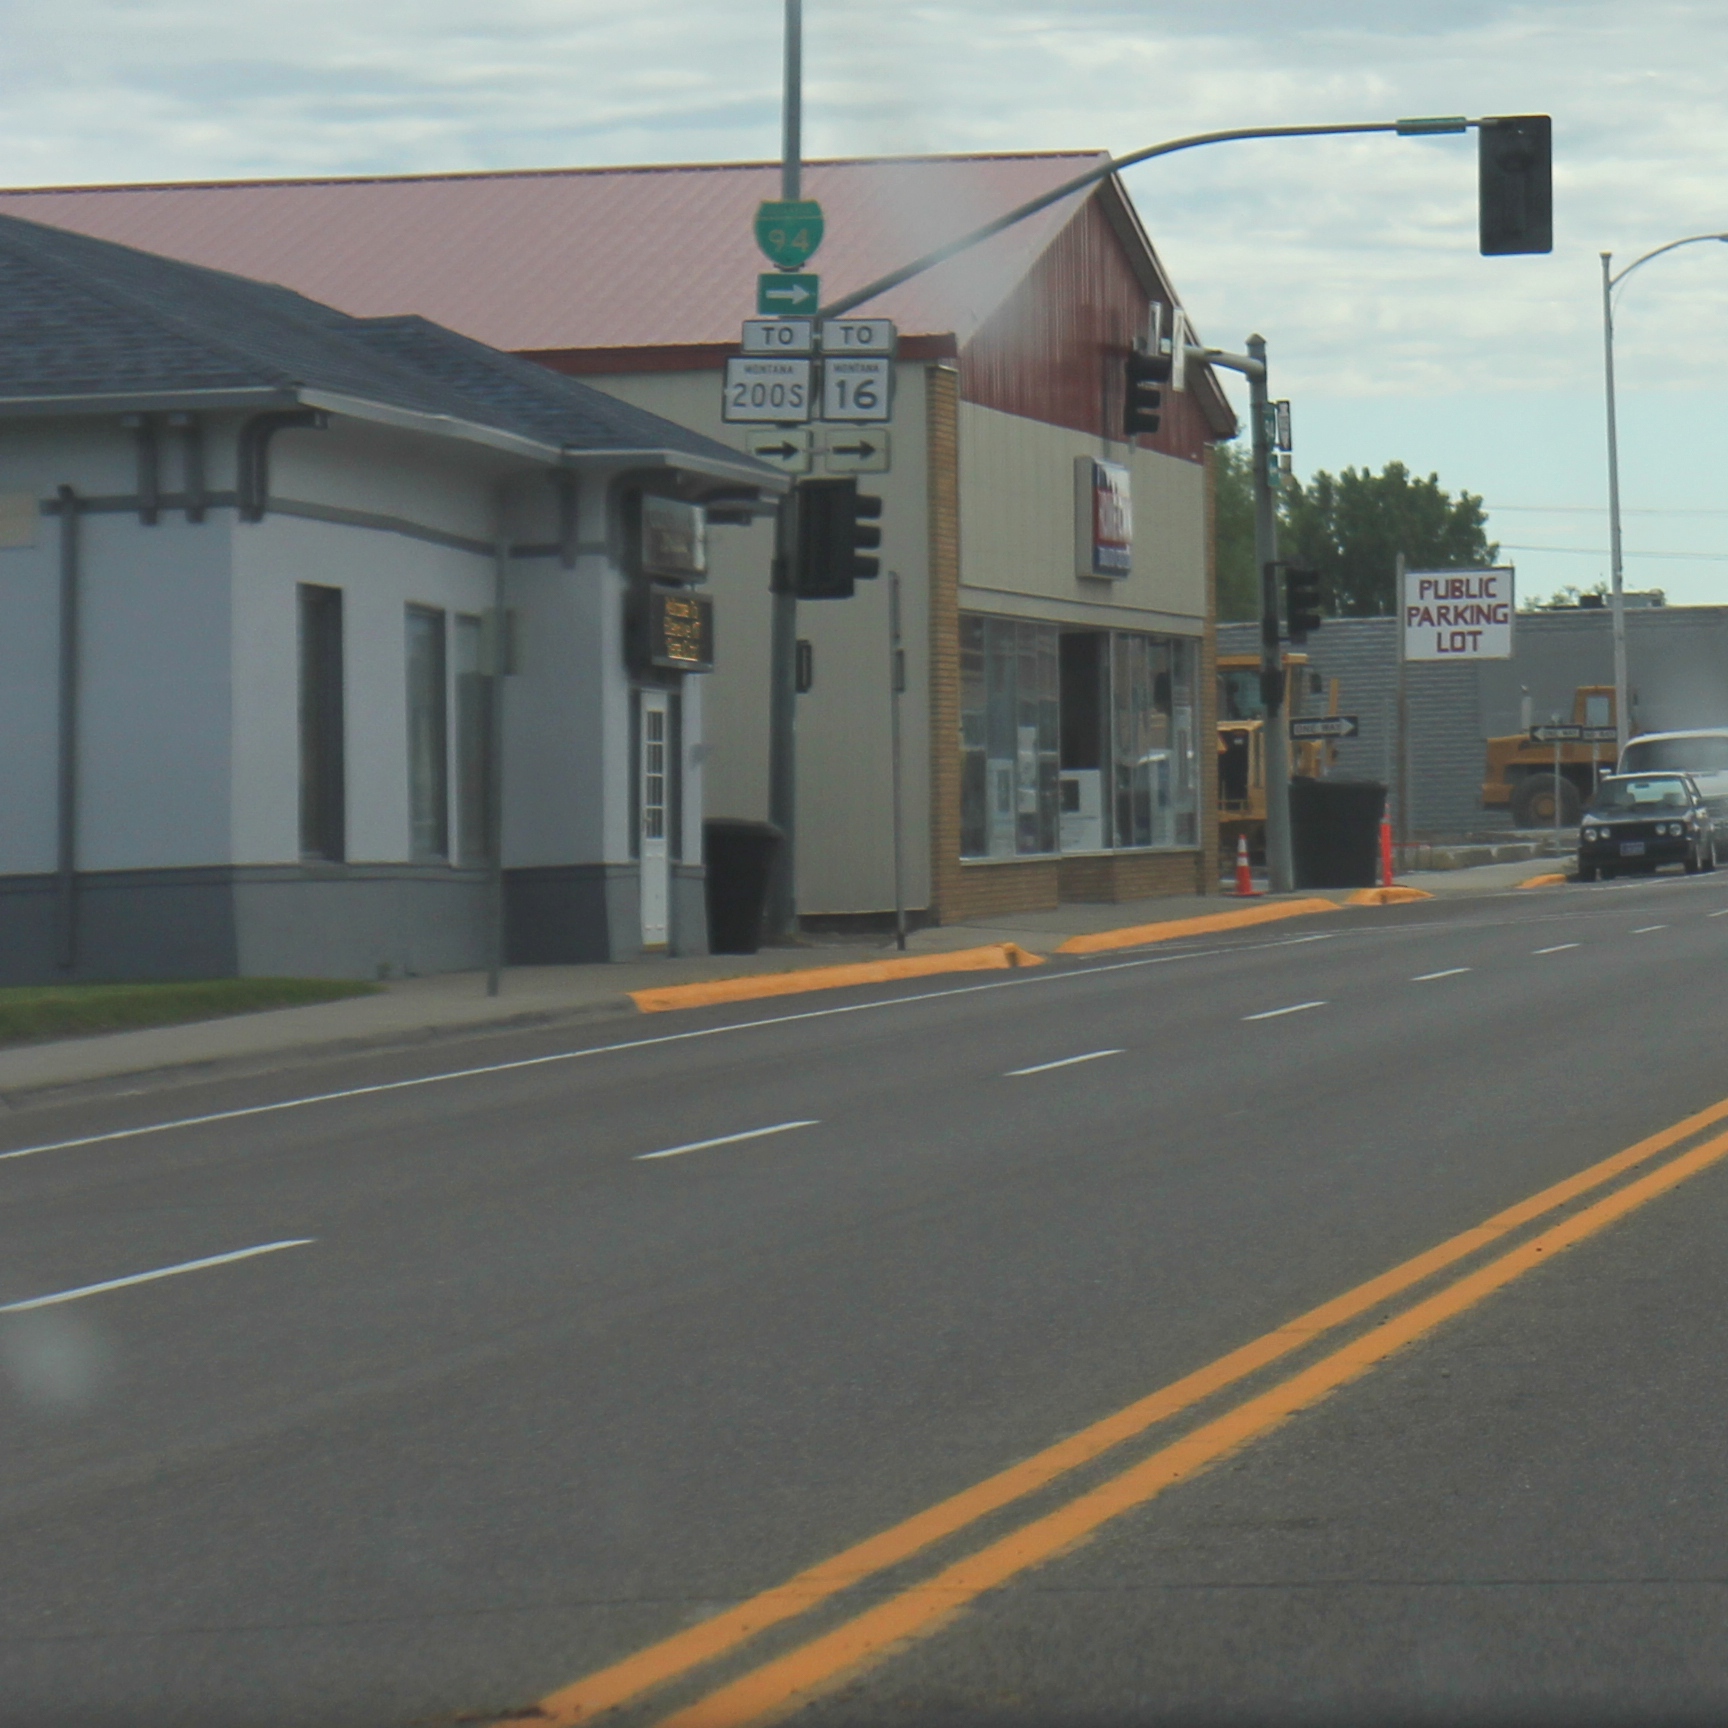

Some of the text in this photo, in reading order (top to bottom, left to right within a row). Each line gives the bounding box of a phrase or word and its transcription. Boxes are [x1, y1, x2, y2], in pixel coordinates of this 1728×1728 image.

[768, 228, 811, 253] 94
[761, 326, 795, 346] TO
[839, 325, 873, 346] TO
[744, 364, 794, 374] MONTANA
[833, 363, 880, 373] MONTANA
[732, 382, 804, 408] 200S
[834, 379, 878, 410] 16
[1419, 577, 1497, 600] PUBLIC
[1406, 603, 1510, 627] PARKING
[1436, 631, 1482, 653] LOT
